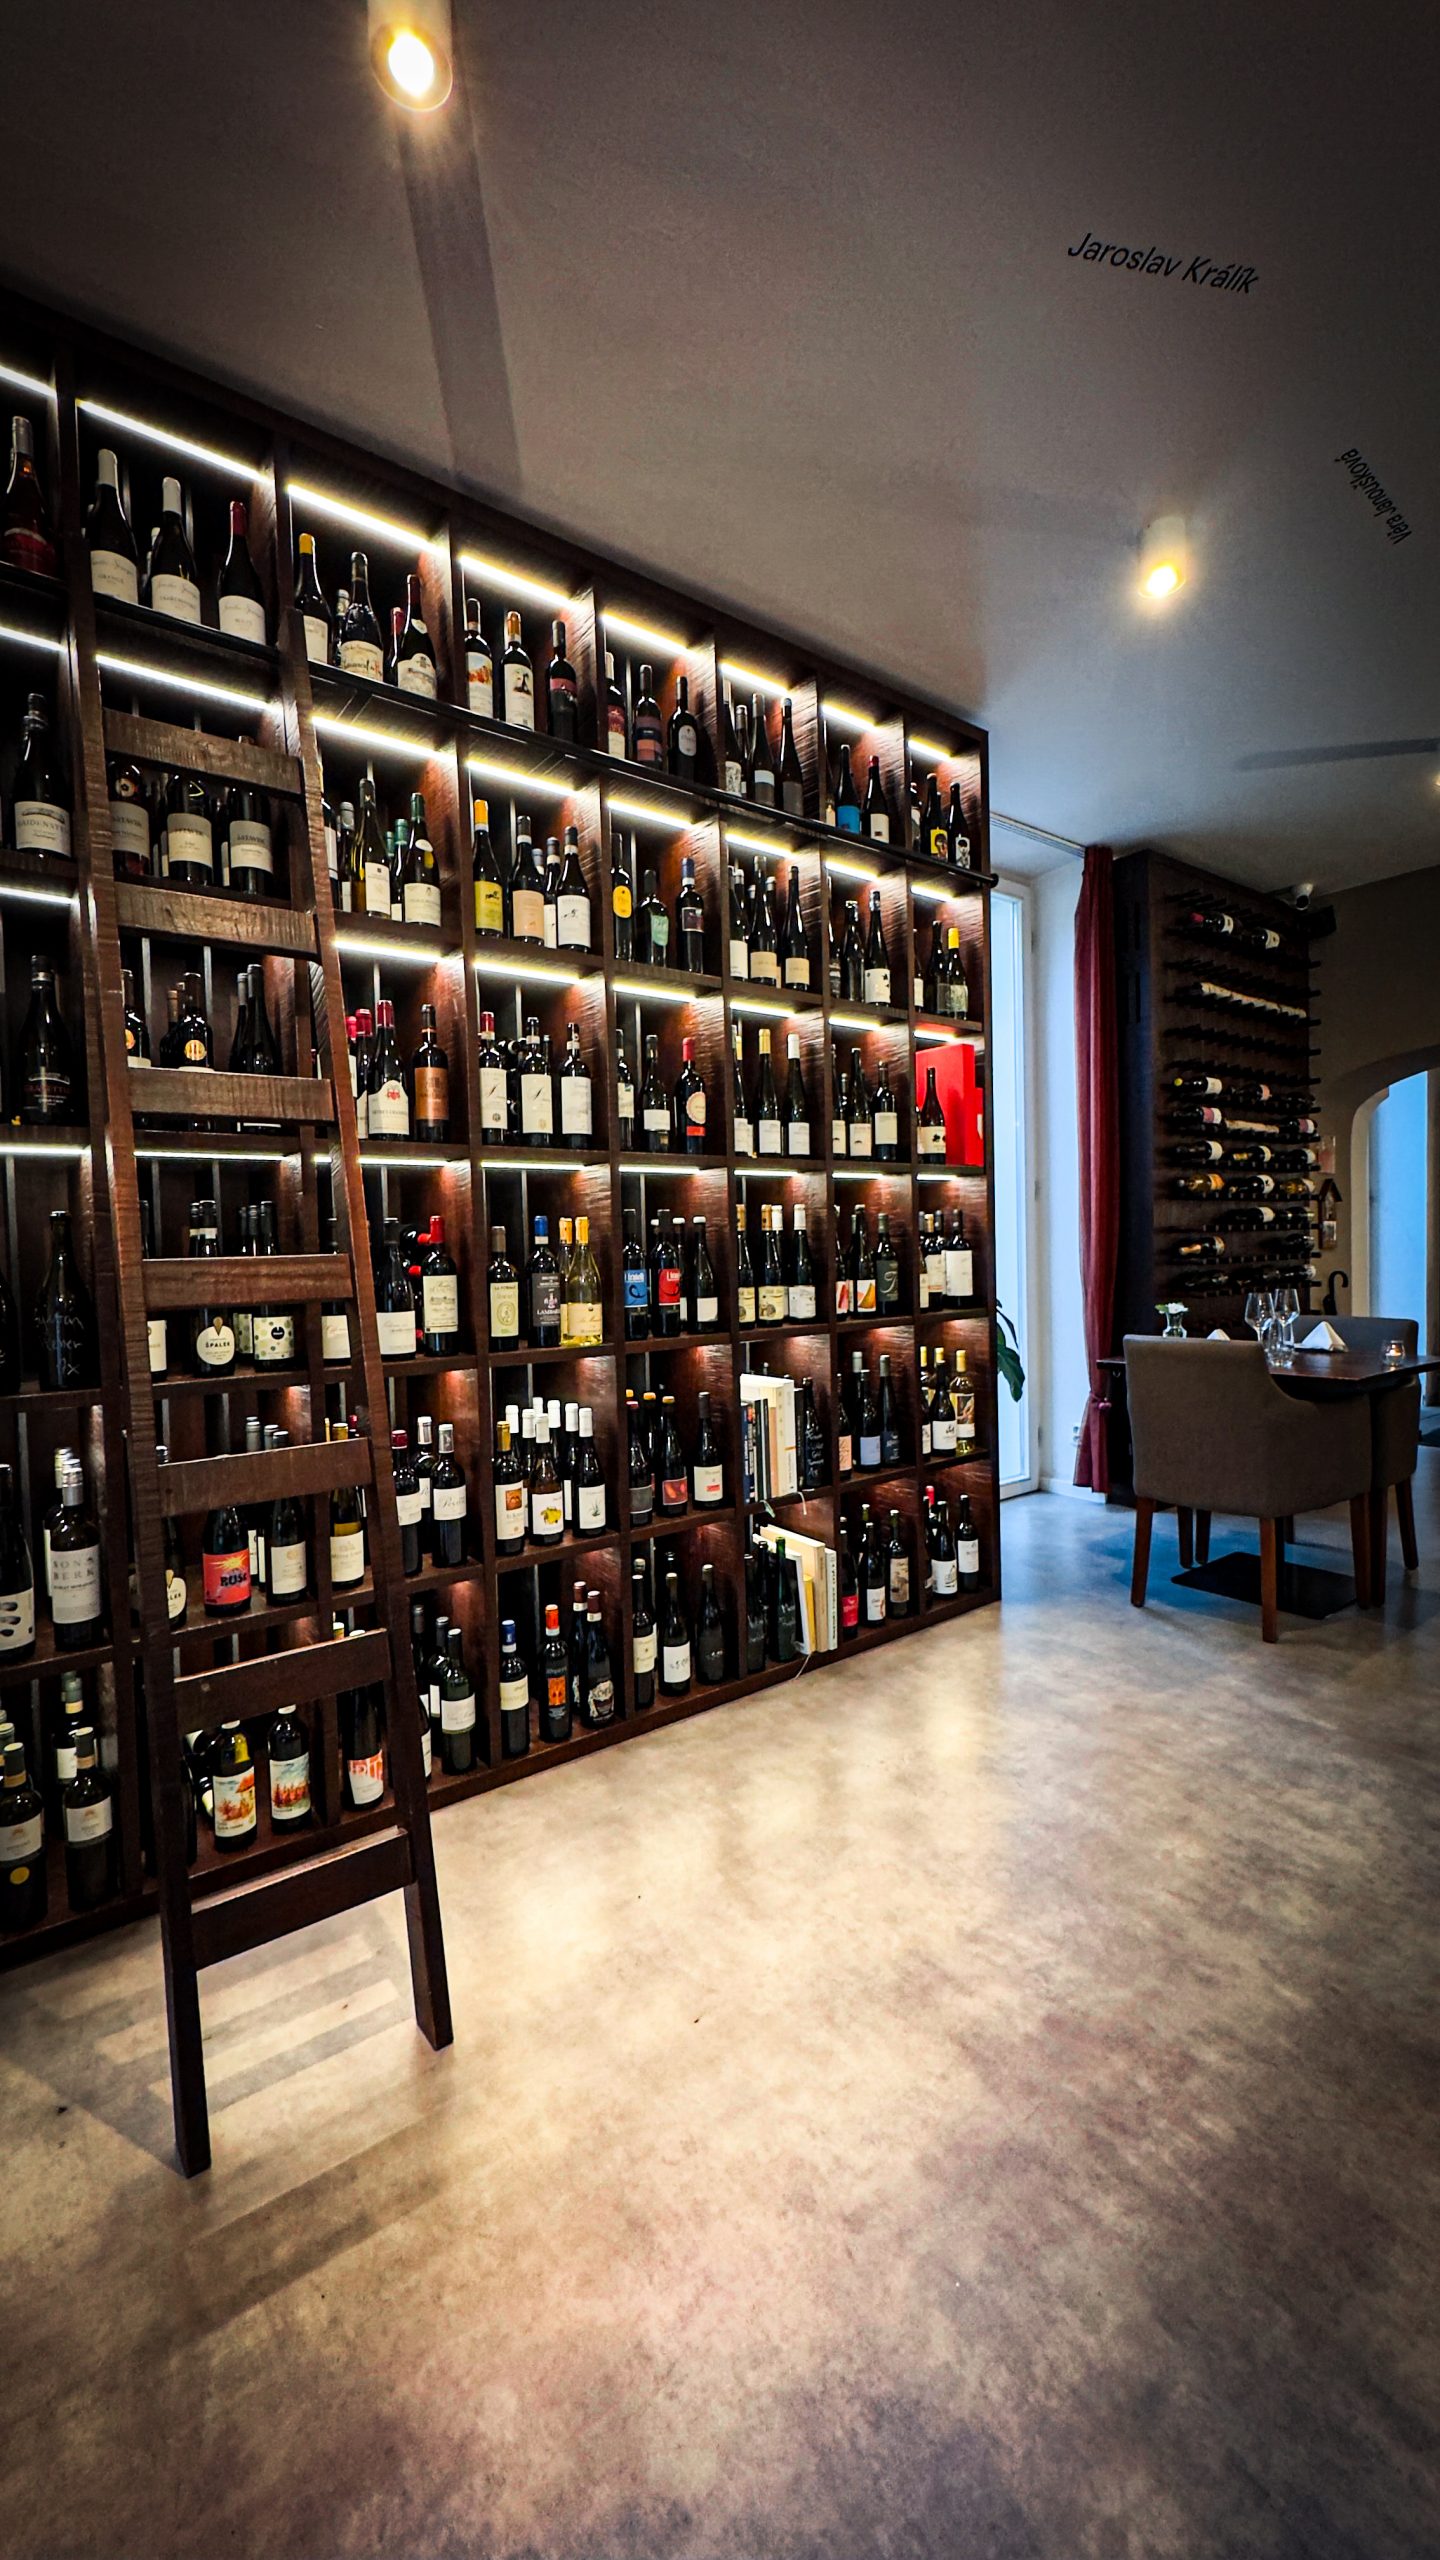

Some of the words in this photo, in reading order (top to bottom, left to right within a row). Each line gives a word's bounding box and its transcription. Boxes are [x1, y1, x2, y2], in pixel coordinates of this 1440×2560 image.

[1067, 232, 1183, 278] Jaroslav
[1181, 255, 1260, 294] Králík
[1333, 447, 1398, 518] Janoušková
